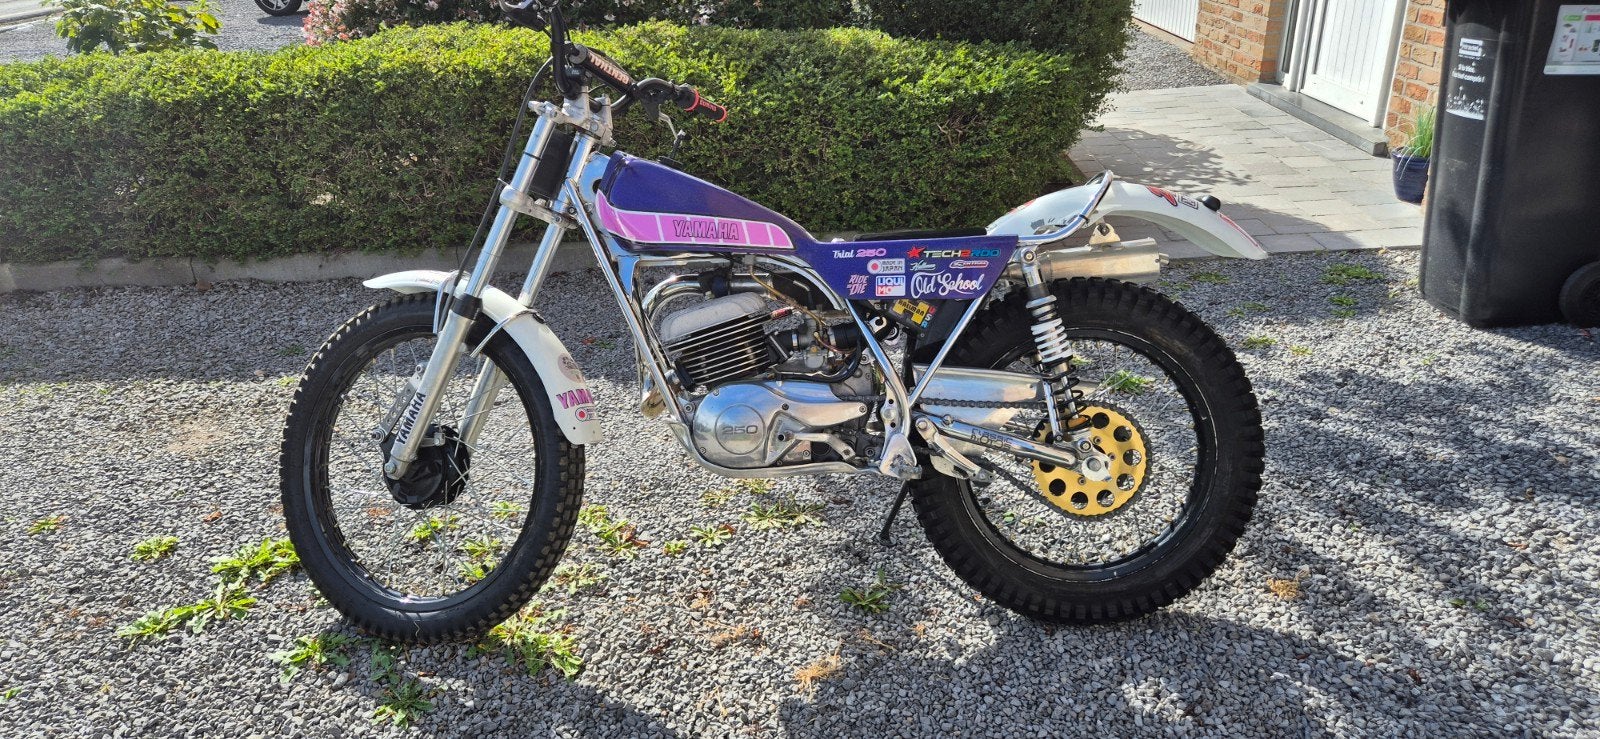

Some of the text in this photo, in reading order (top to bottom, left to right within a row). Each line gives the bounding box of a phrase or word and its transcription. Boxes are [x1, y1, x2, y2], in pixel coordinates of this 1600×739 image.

[672, 219, 739, 240] YAMAHA
[833, 248, 887, 259] Trial 250
[849, 274, 869, 284] RIDE
[878, 278, 905, 286] LIQUI
[911, 270, 985, 299] Old School
[850, 284, 867, 295] DIE
[396, 392, 427, 444] YAMAHA
[722, 424, 758, 435] 250
